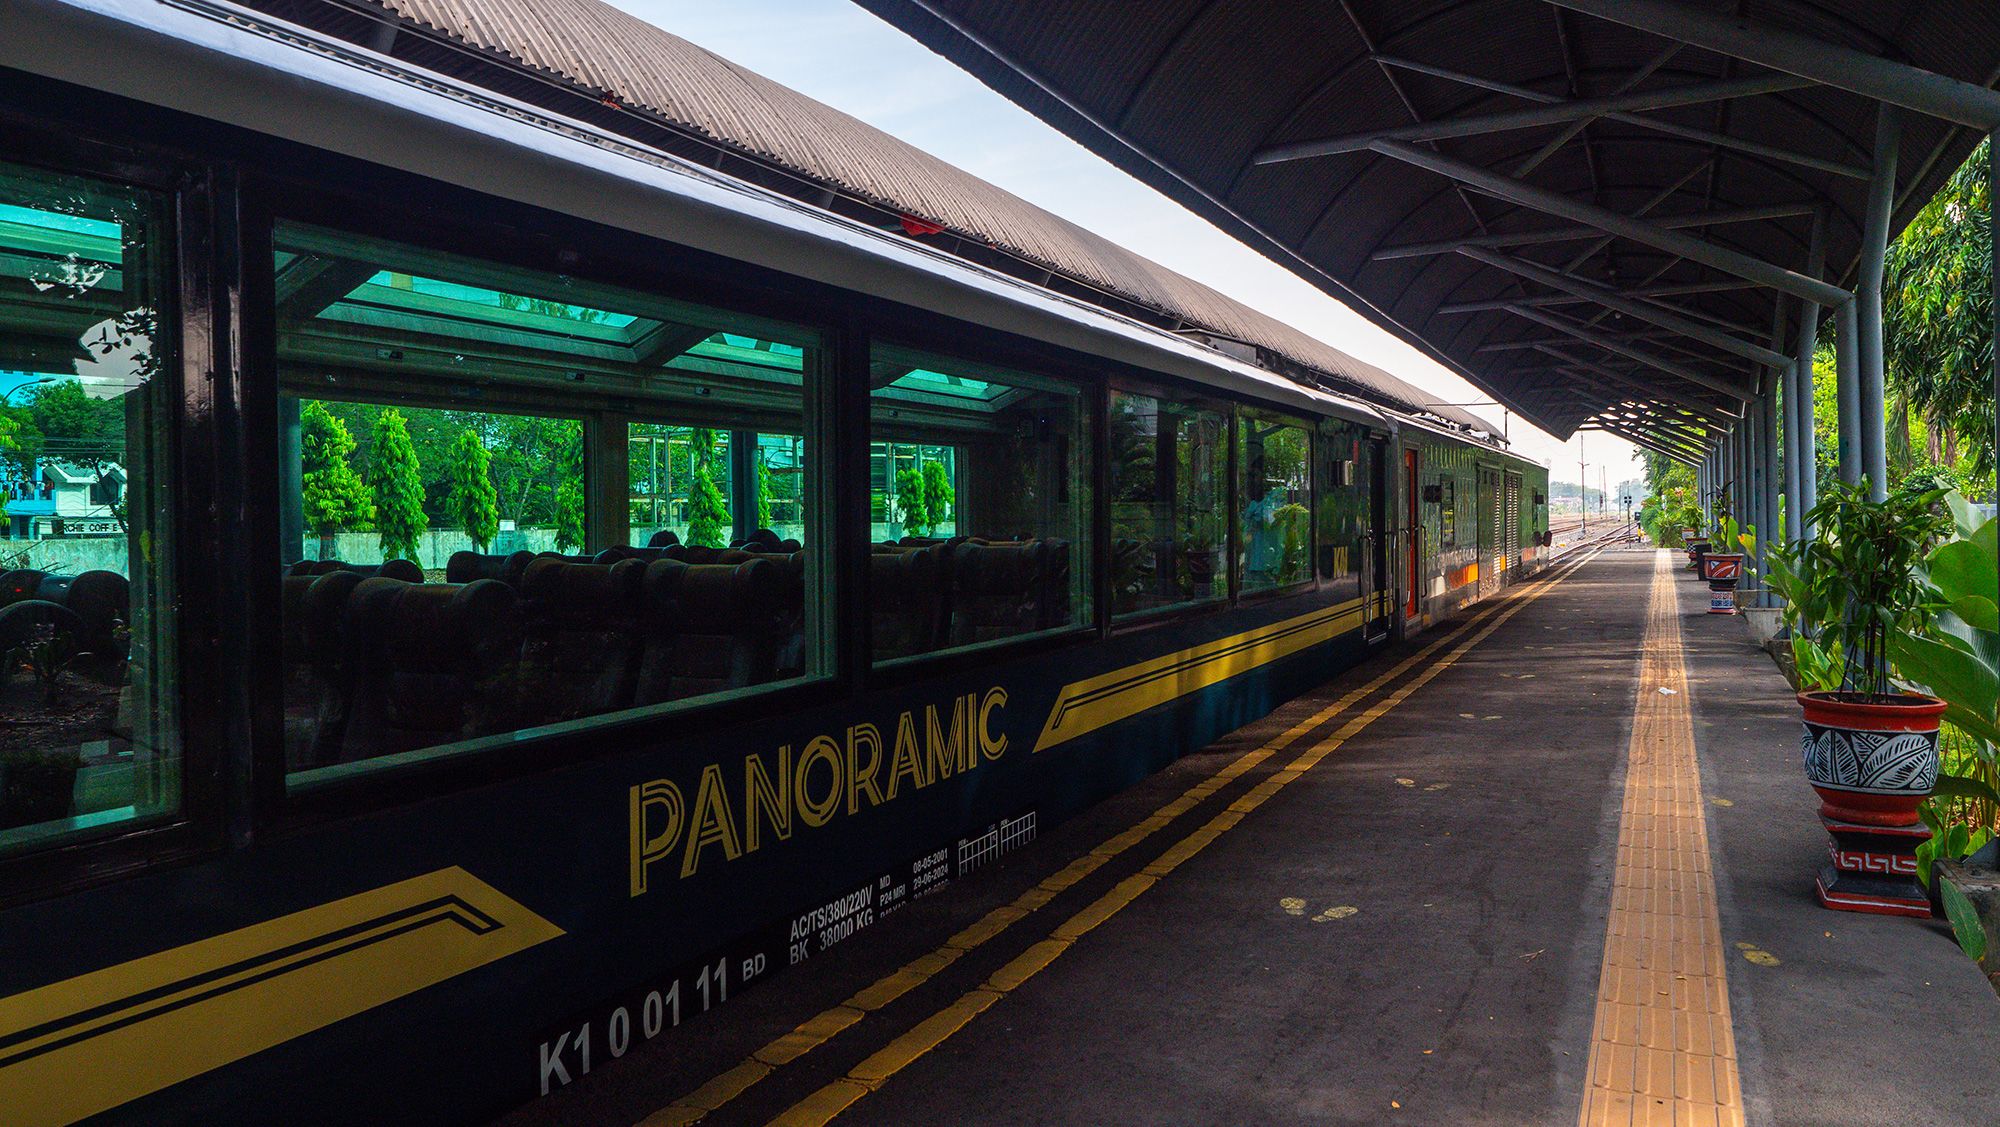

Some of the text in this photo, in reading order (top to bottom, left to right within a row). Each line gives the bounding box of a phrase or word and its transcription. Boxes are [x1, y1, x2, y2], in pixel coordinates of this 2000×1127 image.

[630, 686, 1008, 898] PANORAMIC
[879, 848, 948, 889] MD 08-05-2001
[879, 894, 892, 907] P24
[893, 884, 906, 901] MRI
[913, 863, 949, 890] 29-06-2024
[790, 884, 873, 942] AC/TS/380/220V
[790, 938, 809, 965] BK
[819, 917, 853, 952] 38000
[856, 907, 873, 931] KG
[540, 1021, 591, 1097] K1
[643, 979, 680, 1040] 01
[696, 957, 727, 1012] 11
[742, 952, 766, 982] BD
